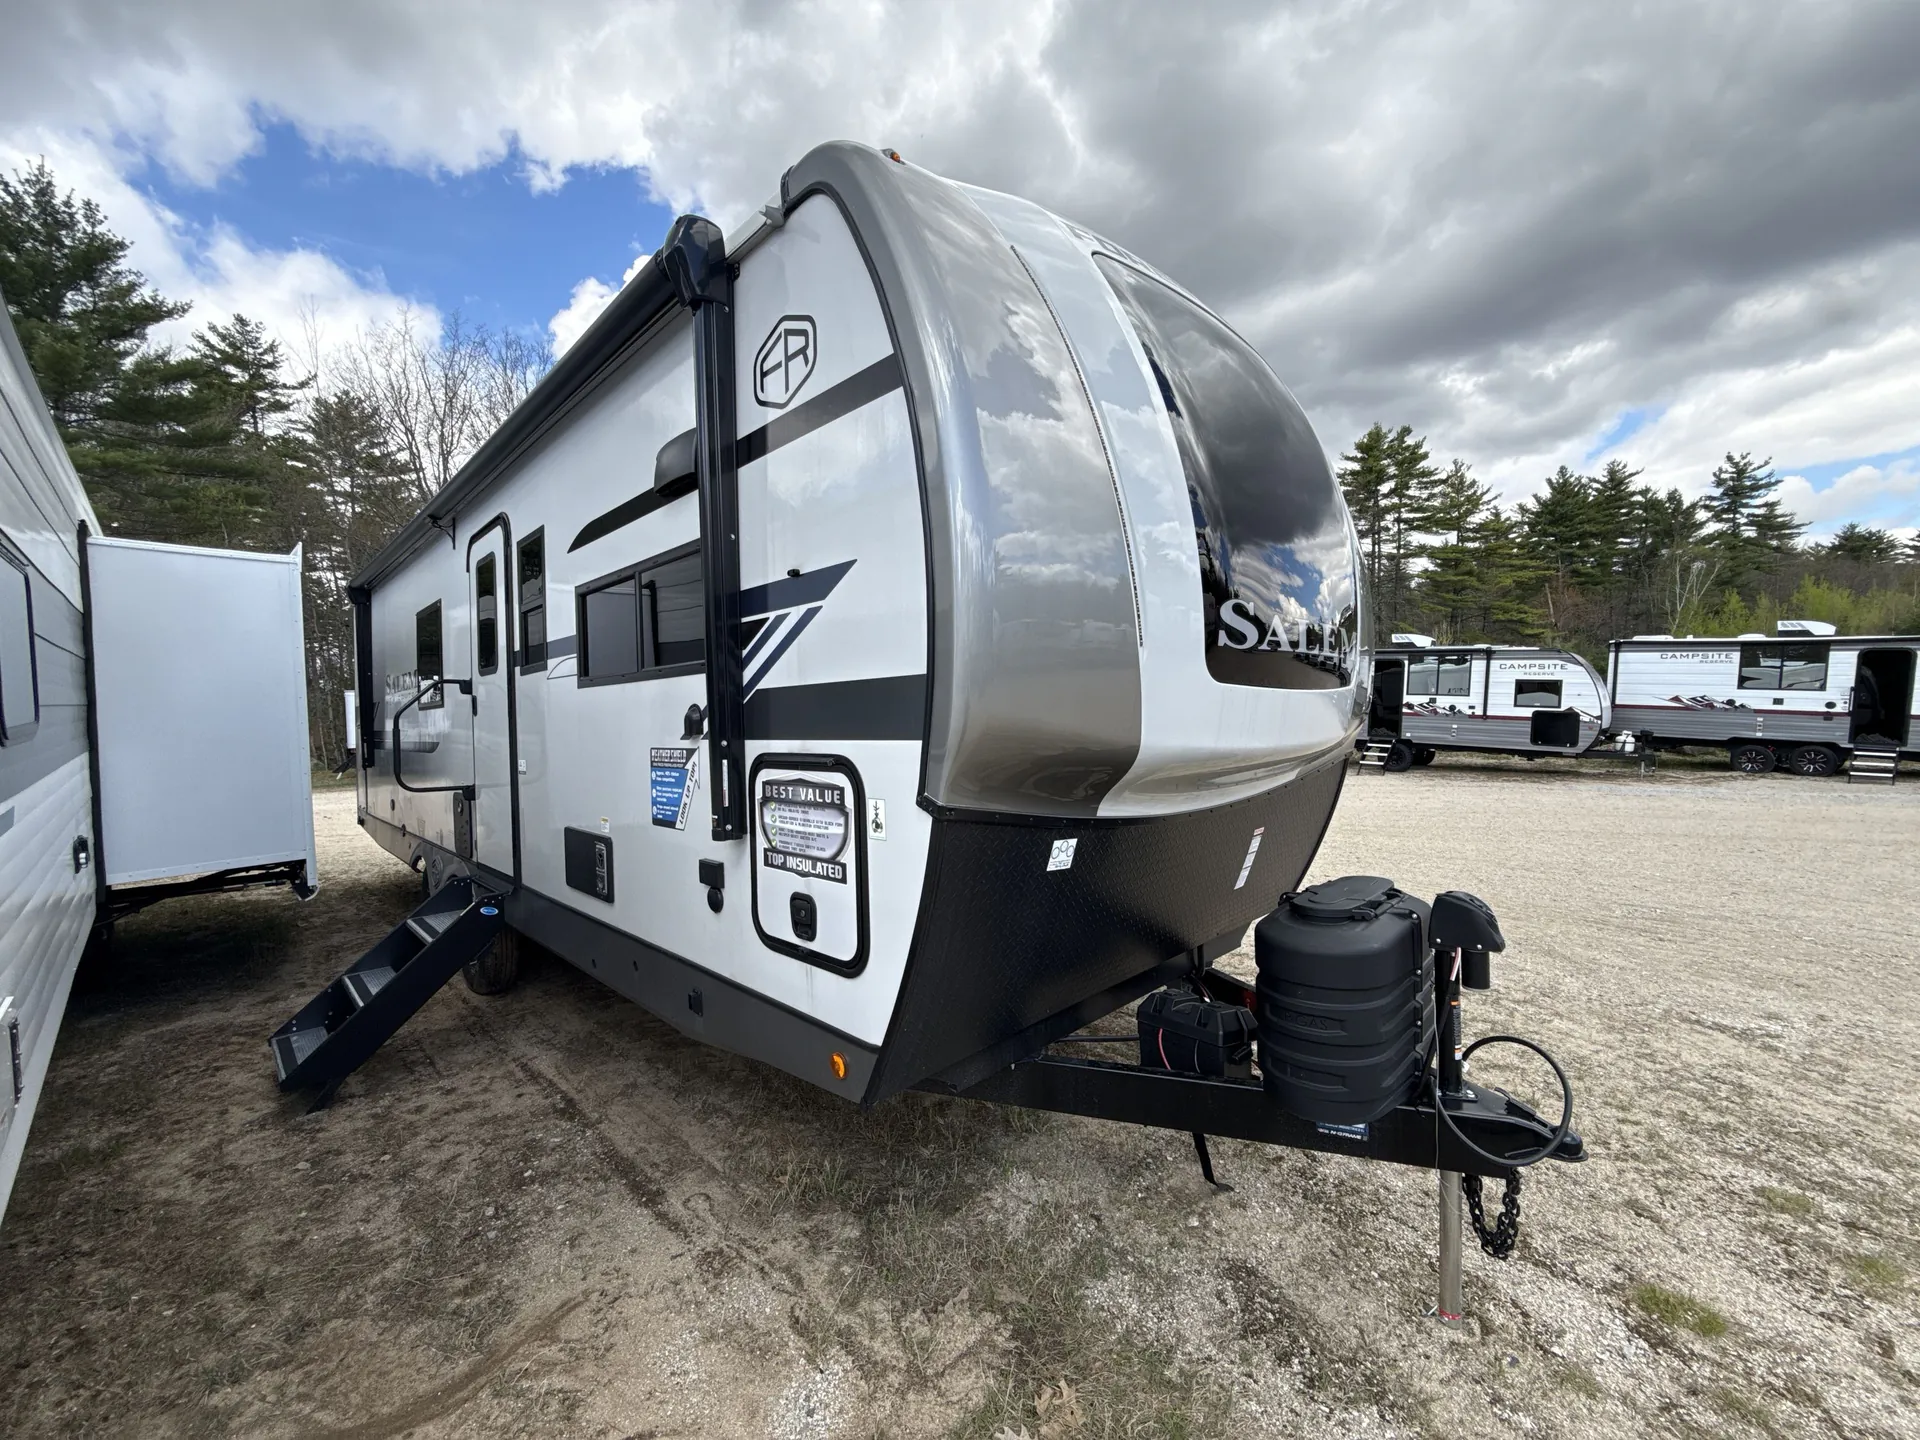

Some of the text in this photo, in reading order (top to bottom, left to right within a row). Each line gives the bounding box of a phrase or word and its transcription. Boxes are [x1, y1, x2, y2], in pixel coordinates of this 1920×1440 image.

[1659, 652, 1734, 660] CAMPSITE
[765, 784, 841, 804] BEST VALUE
[679, 802, 688, 825] LOOK
[685, 785, 691, 799] UP
[766, 851, 843, 880] TOP INSULATED
[1296, 1014, 1329, 1031] GAS
